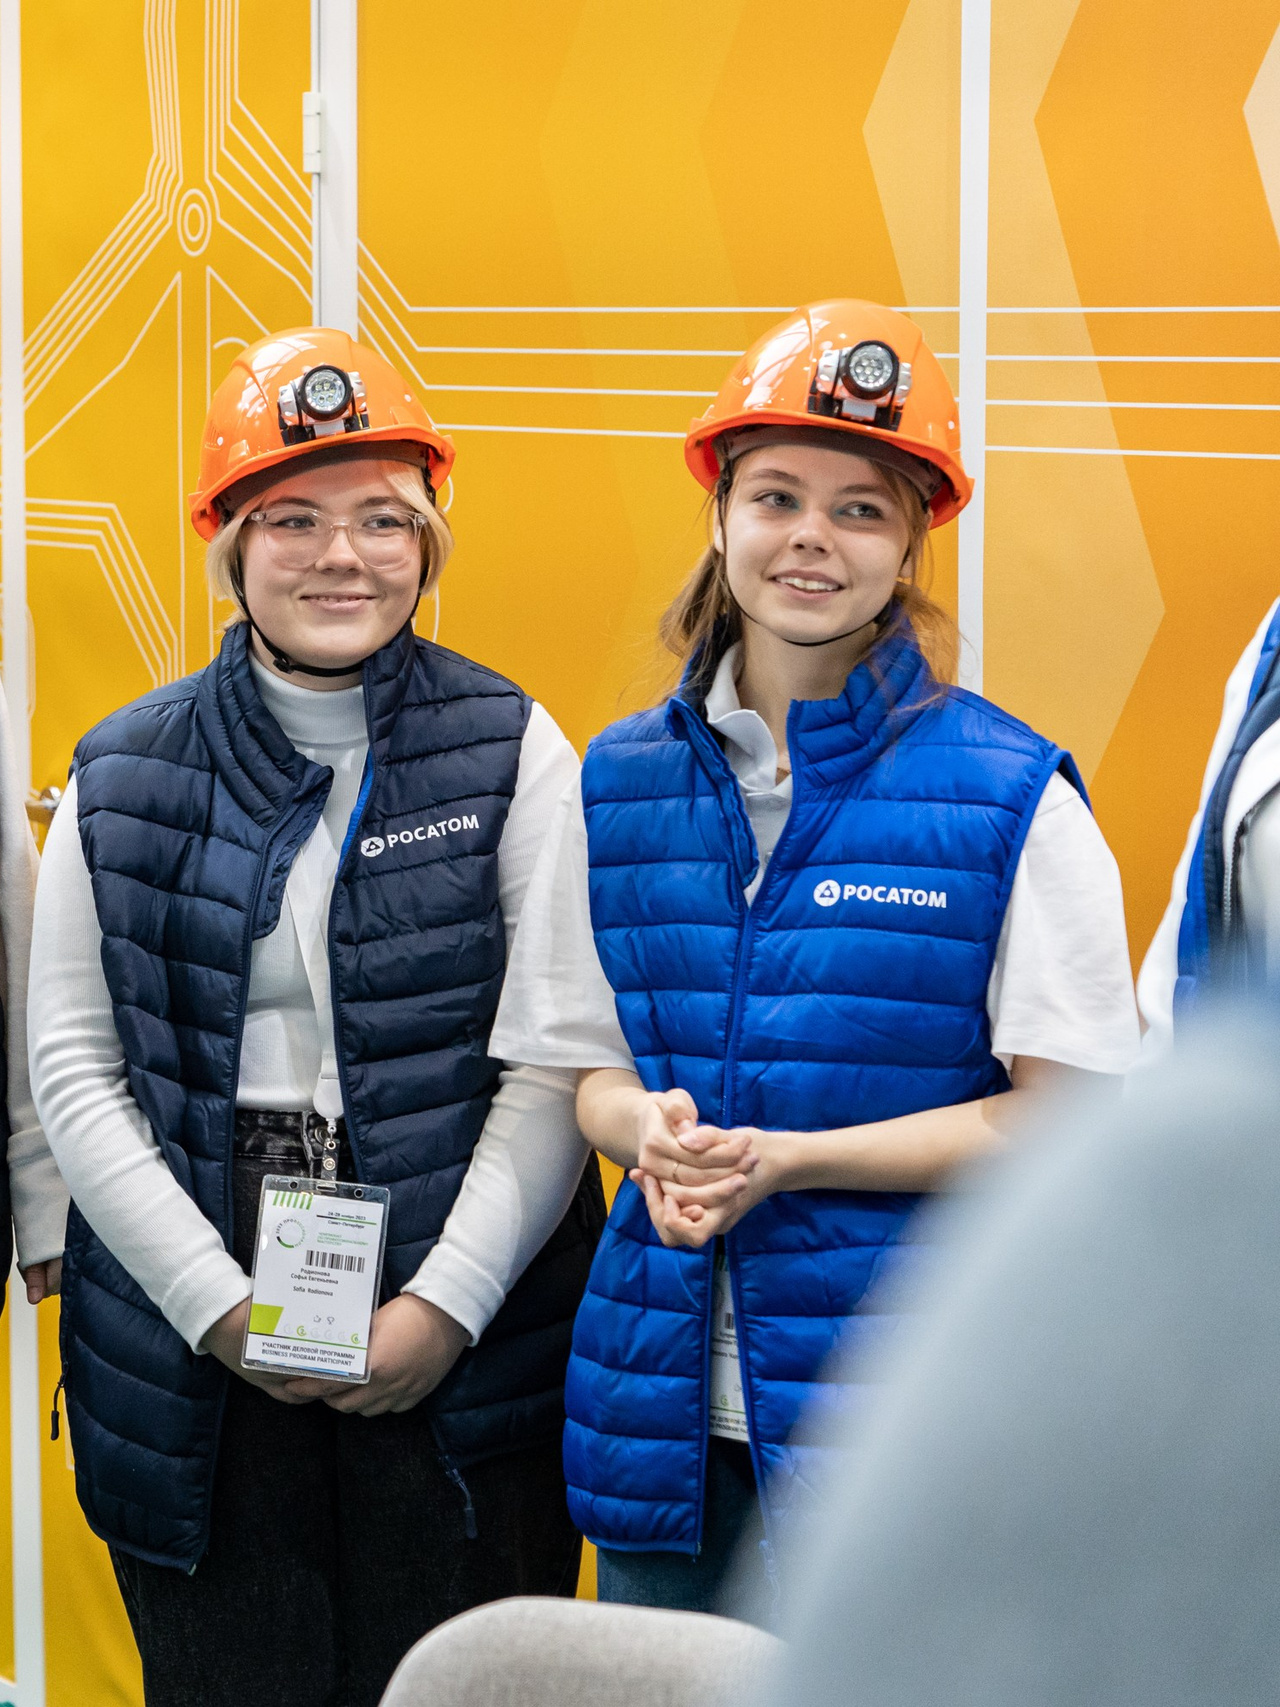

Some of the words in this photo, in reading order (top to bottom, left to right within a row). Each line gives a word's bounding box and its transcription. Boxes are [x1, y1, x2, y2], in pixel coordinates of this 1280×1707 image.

[386, 814, 480, 848] РОСАТОМ
[843, 884, 947, 908] РОСАТОМ
[290, 1273, 308, 1281] Софья
[308, 1275, 339, 1284] Евгеньевна
[300, 1268, 330, 1277] Родионова
[307, 1288, 334, 1296] Rodionova
[261, 1348, 288, 1358] BUSINESS
[289, 1352, 316, 1362] PROGRAM
[317, 1356, 352, 1366] PARTICIPANT
[262, 1342, 292, 1351] УЧАСТНИК
[292, 1344, 318, 1355] ДЕЛОВОЙ
[320, 1349, 355, 1360] ПРОГРАММЫ
